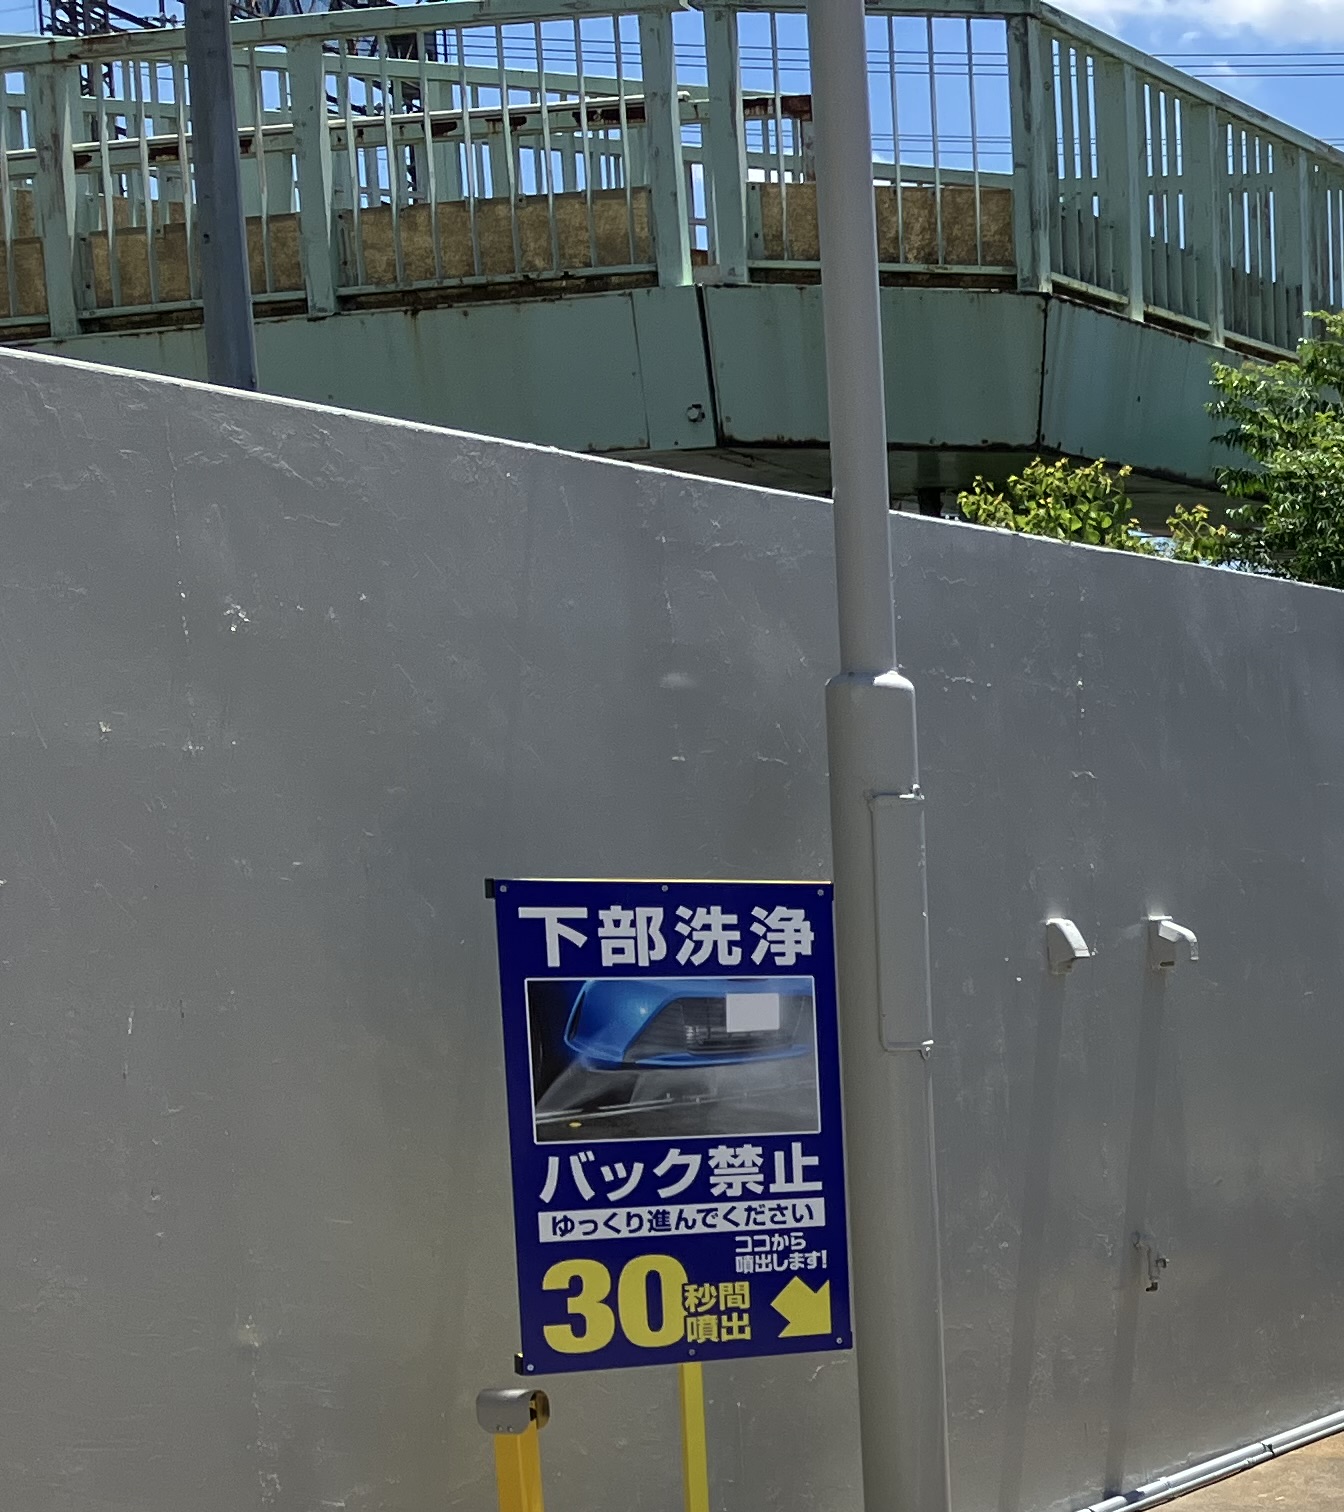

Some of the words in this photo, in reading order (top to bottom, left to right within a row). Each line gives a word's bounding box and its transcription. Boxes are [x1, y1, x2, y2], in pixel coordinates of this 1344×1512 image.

[518, 905, 815, 968] 下部洗浄
[539, 1142, 823, 1203] バック禁止
[551, 1203, 814, 1238] ゆっくり進んでください
[735, 1232, 806, 1253] ココから
[542, 1254, 688, 1354] 30
